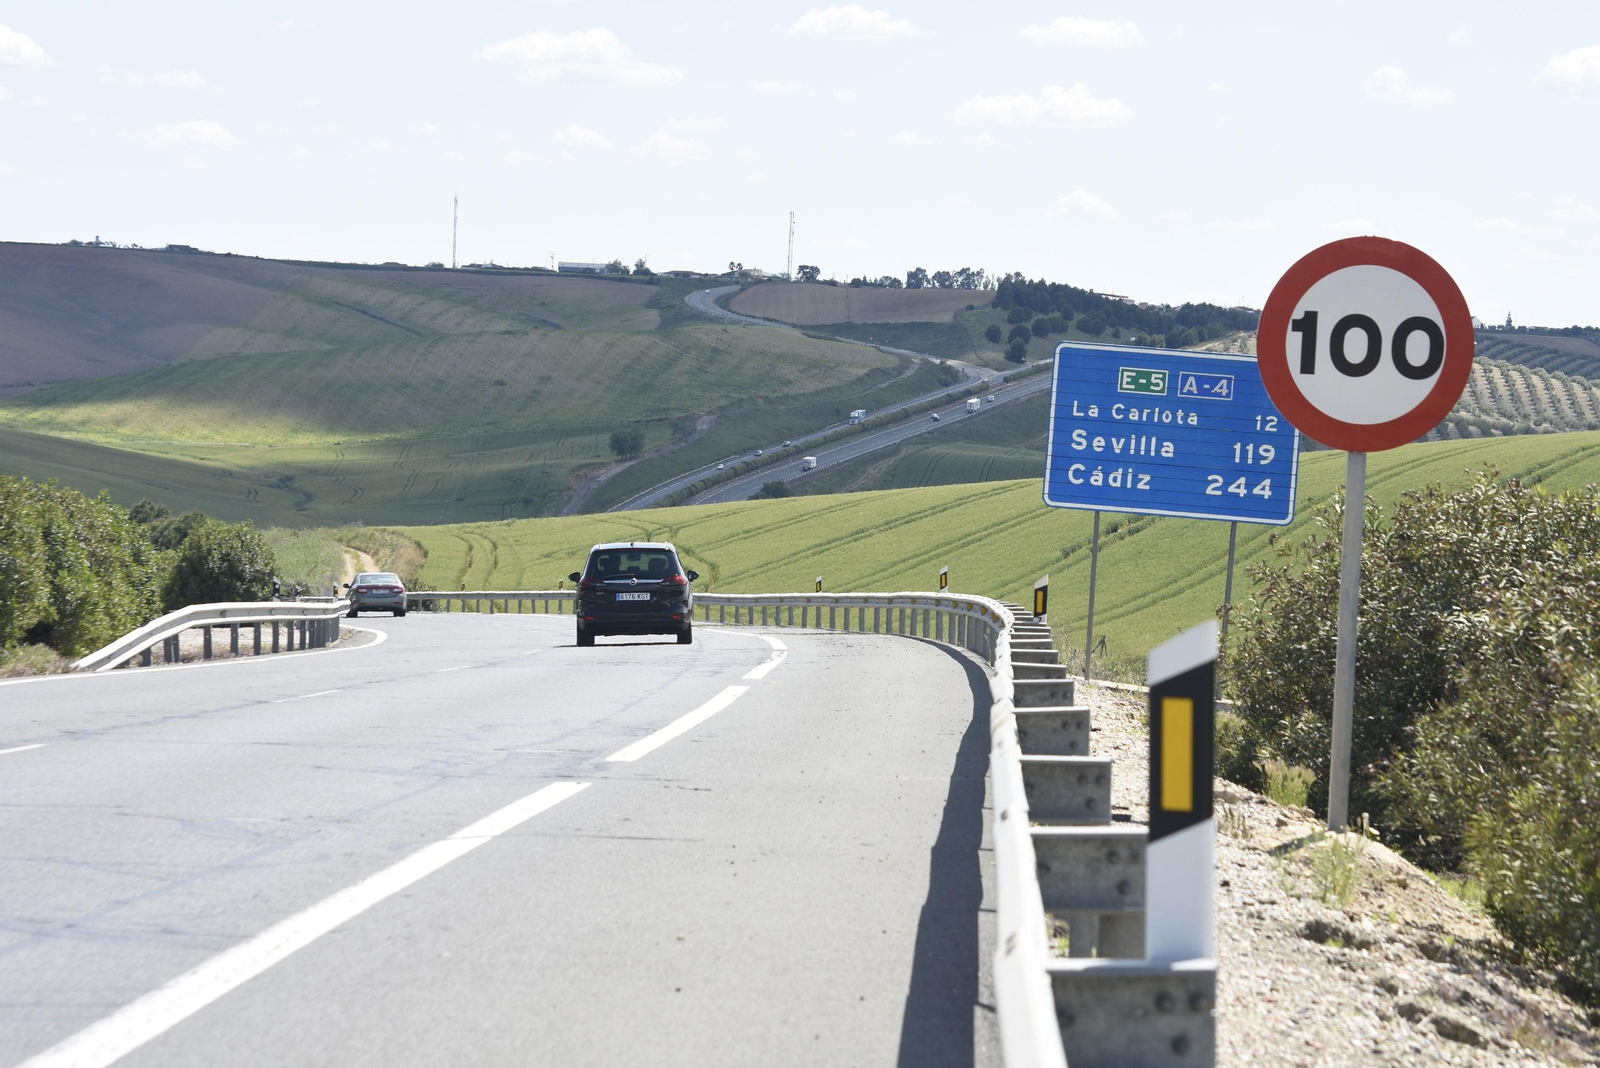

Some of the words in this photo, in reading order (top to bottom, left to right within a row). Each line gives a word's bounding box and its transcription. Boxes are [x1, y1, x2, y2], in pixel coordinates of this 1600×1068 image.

[1291, 310, 1445, 381] 100
[1122, 371, 1165, 391] E-5
[1182, 376, 1229, 396] A-4
[1072, 400, 1099, 418] La
[1111, 403, 1198, 426] Carlota
[1255, 414, 1278, 432] 12
[1071, 429, 1175, 458] Sevilla
[1233, 442, 1276, 465] 119
[1067, 462, 1151, 490] Cádiz
[1205, 474, 1273, 500] 244
